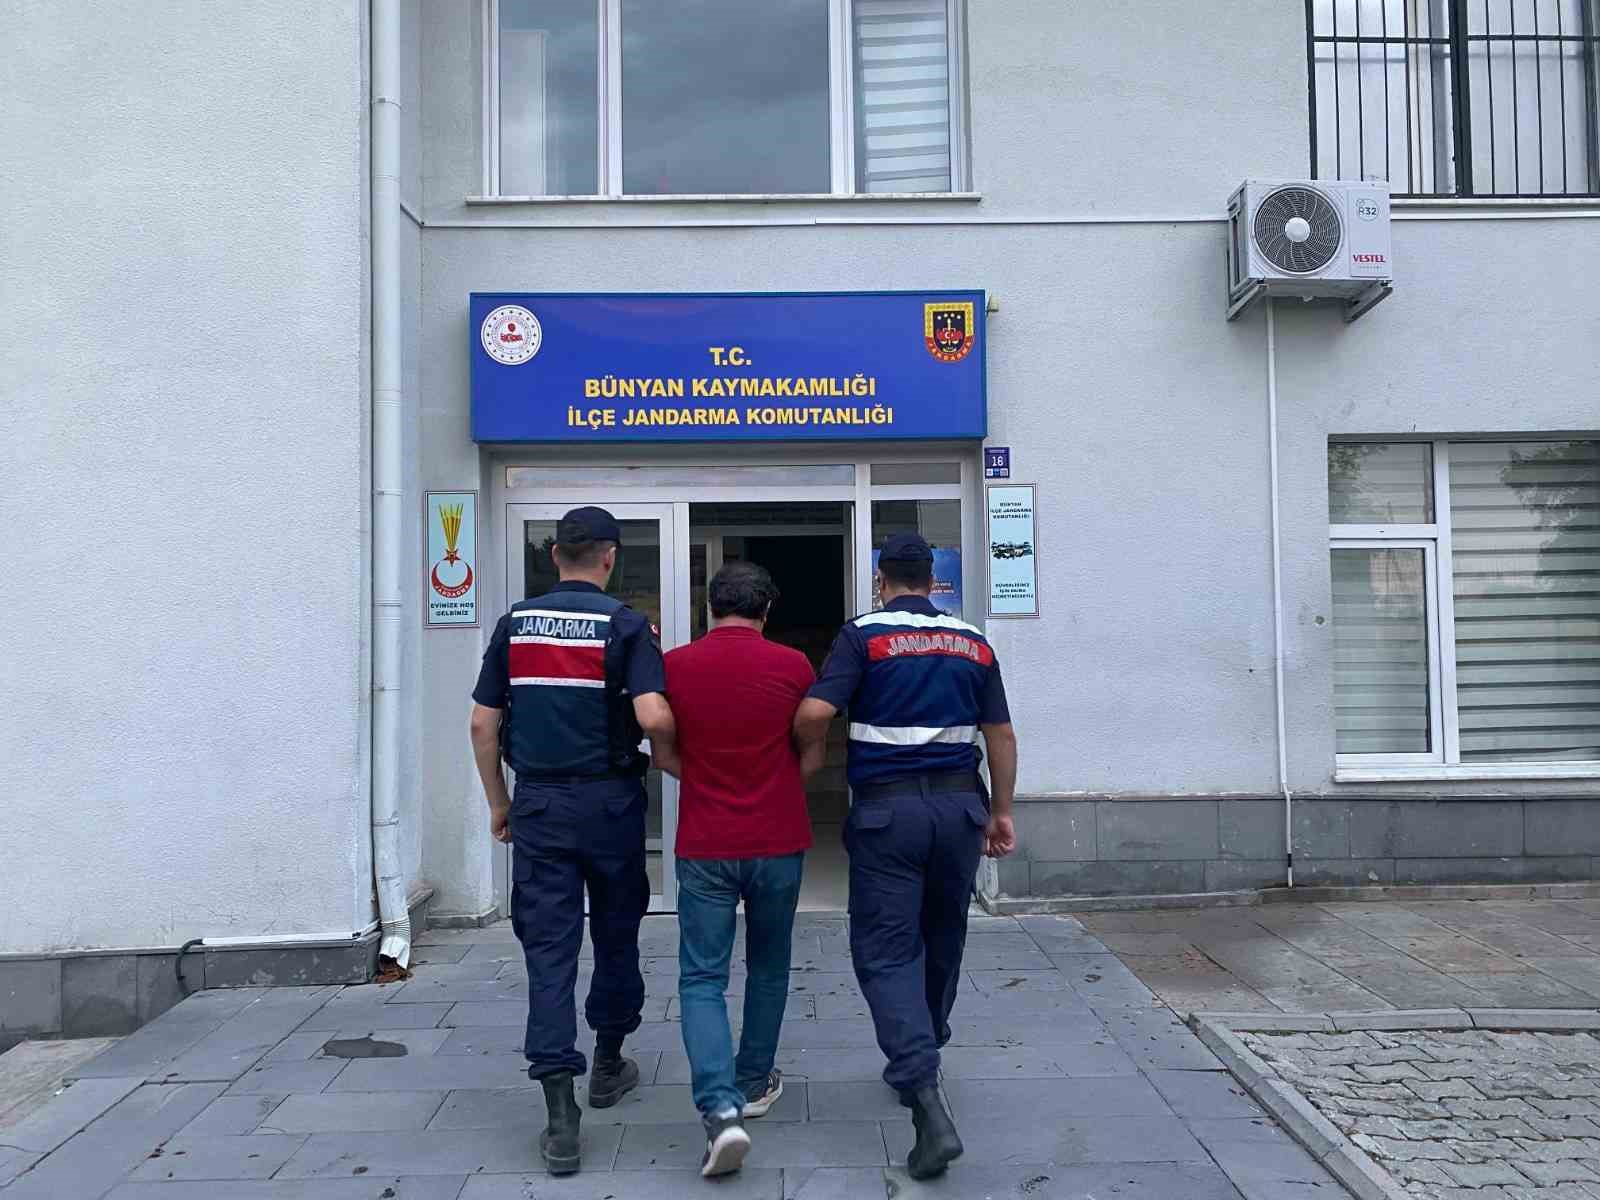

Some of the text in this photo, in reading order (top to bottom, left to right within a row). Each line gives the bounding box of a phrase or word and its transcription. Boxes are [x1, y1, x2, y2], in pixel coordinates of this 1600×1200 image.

[1352, 254, 1386, 263] VESTEL
[709, 346, 752, 366] T.C.
[584, 373, 876, 398] BÜNYAN KAYMAKAMLIĞI
[567, 402, 894, 430] İLÇE JANDARMA KOMUTANLIĞI
[517, 616, 596, 638] JANDARMA
[887, 634, 979, 661] JANDARMA
